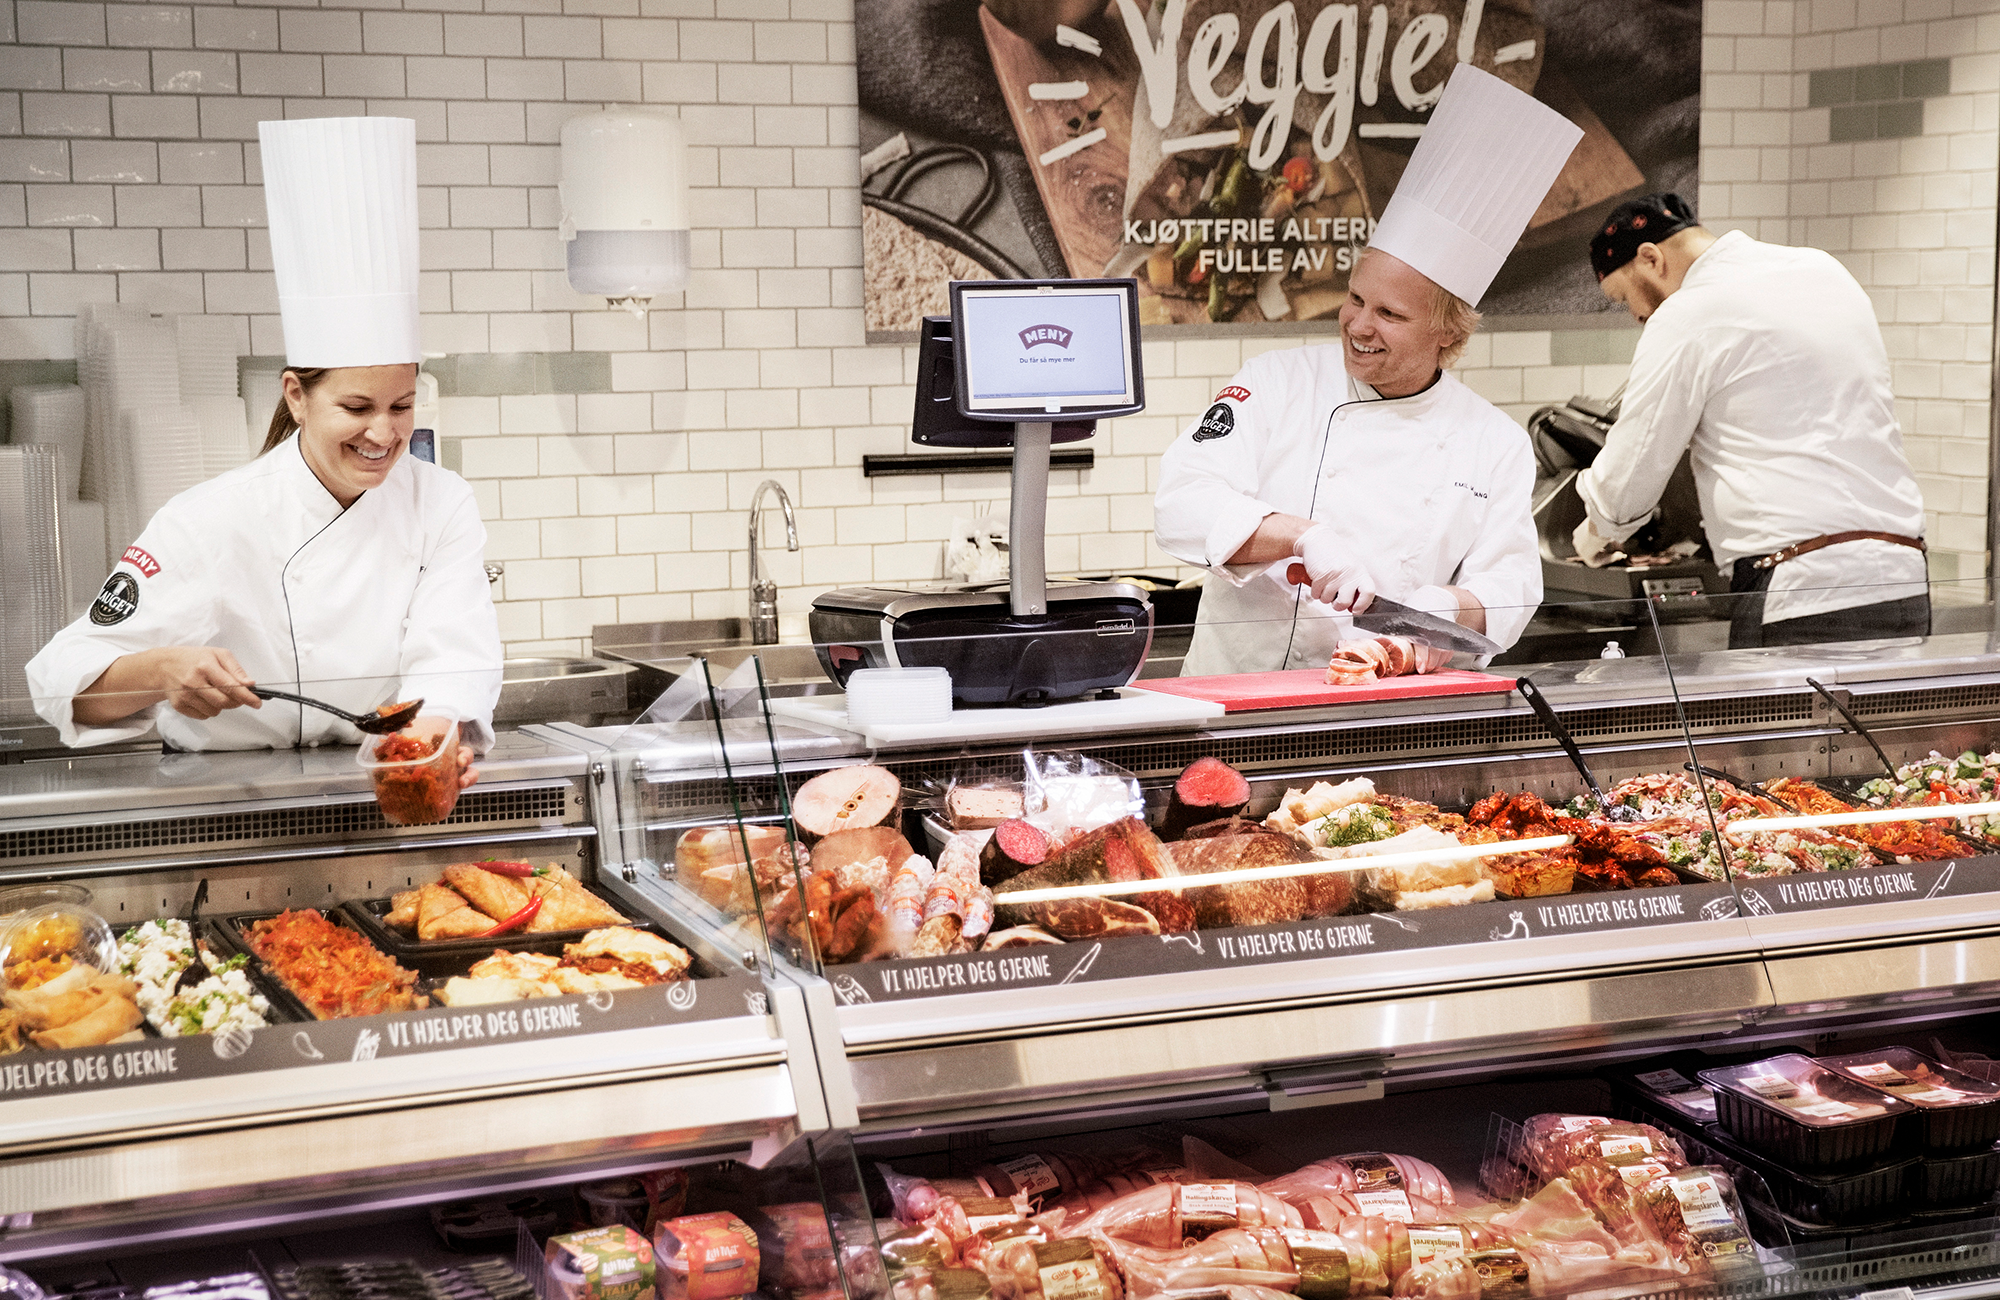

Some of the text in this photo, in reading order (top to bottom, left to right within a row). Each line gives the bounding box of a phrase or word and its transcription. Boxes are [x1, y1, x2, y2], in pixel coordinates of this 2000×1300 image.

[1124, 218, 1275, 245] KJØTTFRIE
[1200, 247, 1284, 273] FULLE
[1291, 247, 1328, 272] AV
[1024, 328, 1068, 344] MENY
[1029, 356, 1039, 364] får
[1039, 356, 1048, 364] så
[1048, 357, 1062, 365] mye
[124, 548, 158, 572] MENY
[1778, 872, 1917, 904] VI HJELPER DEG GJERNE
[1538, 894, 1685, 928] VI HJELPER DEG GJERNE
[1217, 924, 1375, 959] VI HJELPER DEG GJERNE
[881, 955, 1051, 992] VI HJELPER DEG GJERNE
[387, 1003, 582, 1047] VI HJELPER DEG GJERNE
[73, 1055, 109, 1085] DEG
[112, 1047, 178, 1078] GJERNE
[1610, 1144, 1626, 1154] Gilde
[1629, 1169, 1645, 1178] Gilde
[1683, 1200, 1722, 1213] Hallingskarvet
[1412, 1238, 1460, 1249] Hallingskarvet
[600, 1282, 641, 1298] ITALIA
